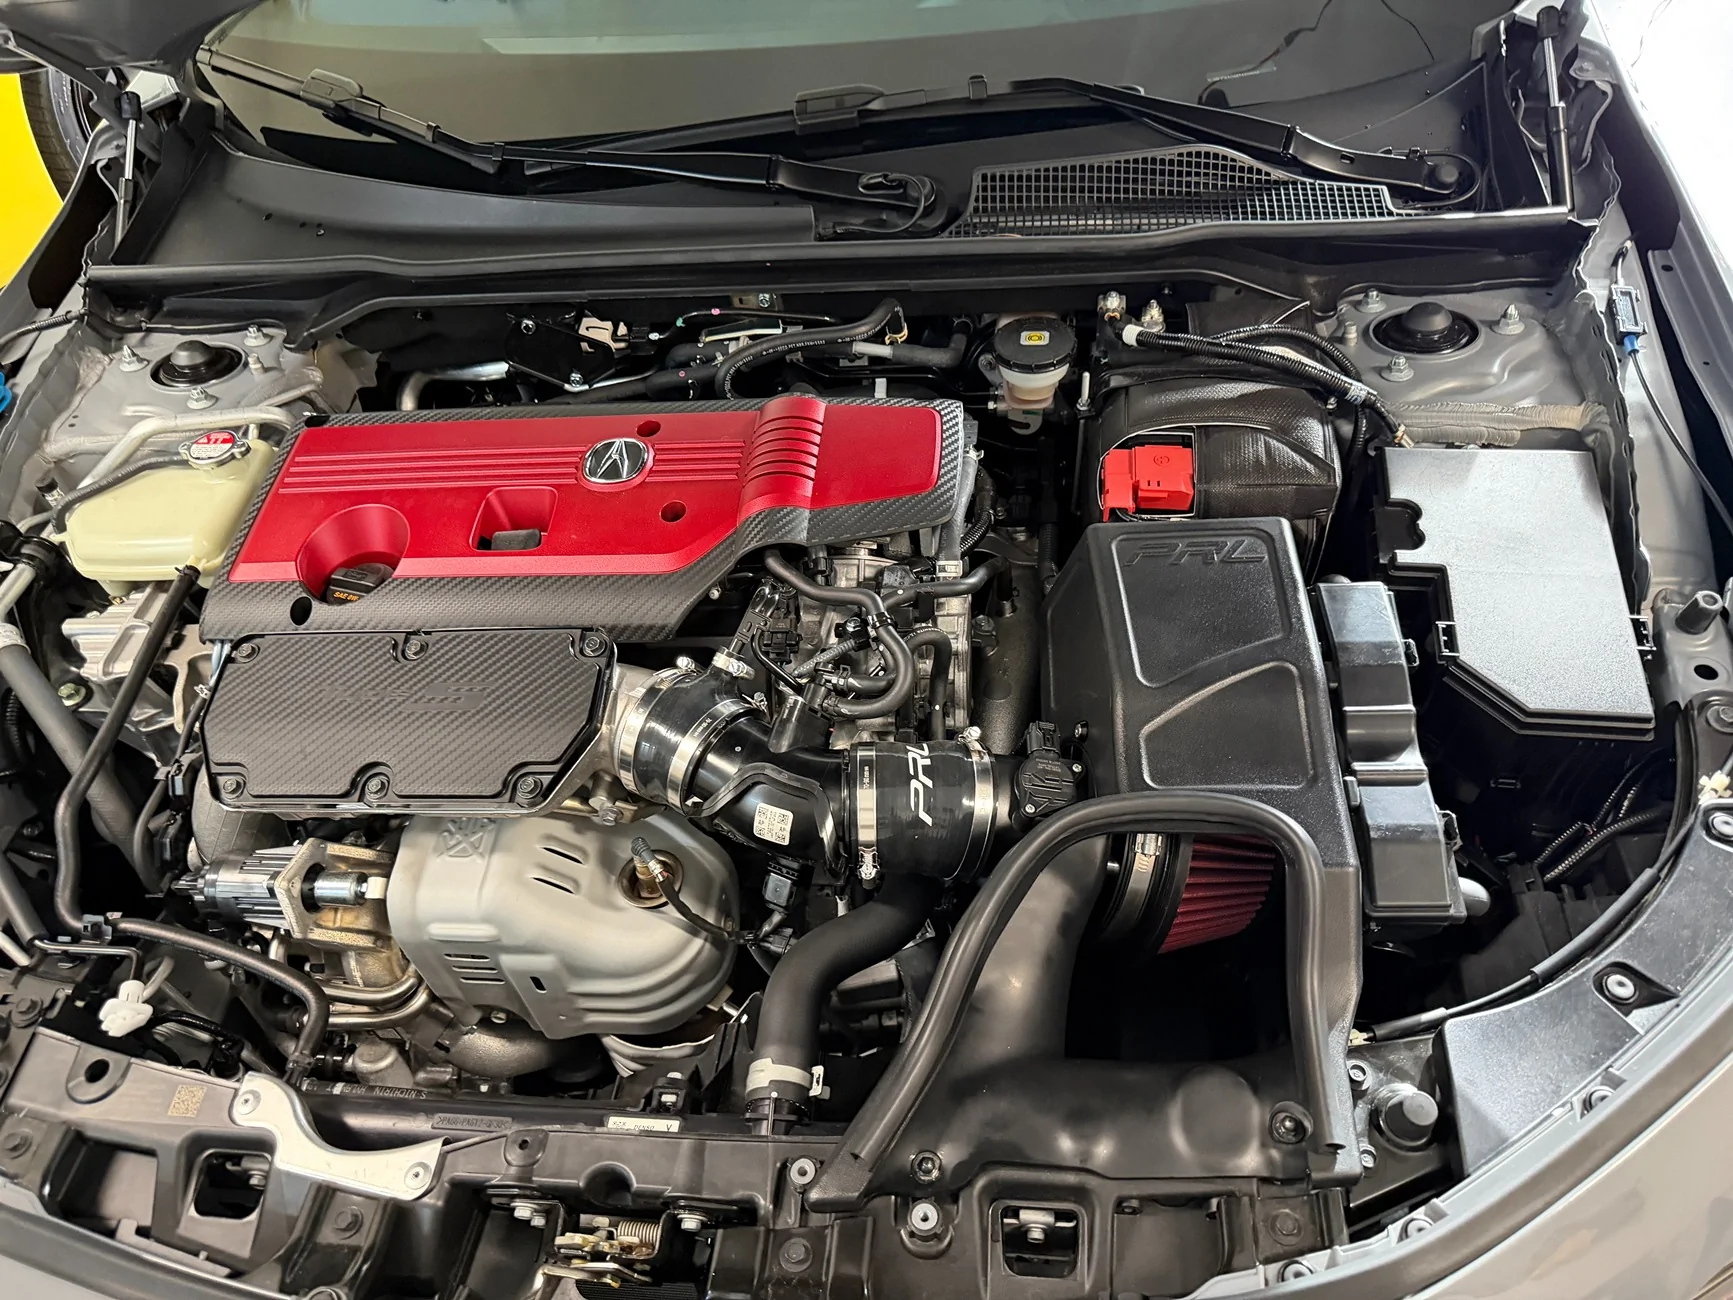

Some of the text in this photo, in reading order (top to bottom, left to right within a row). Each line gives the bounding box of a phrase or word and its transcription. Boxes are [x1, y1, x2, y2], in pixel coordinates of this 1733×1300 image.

[1123, 539, 1268, 567] PRL
[333, 591, 348, 600] SAE
[905, 743, 933, 827] PRL
